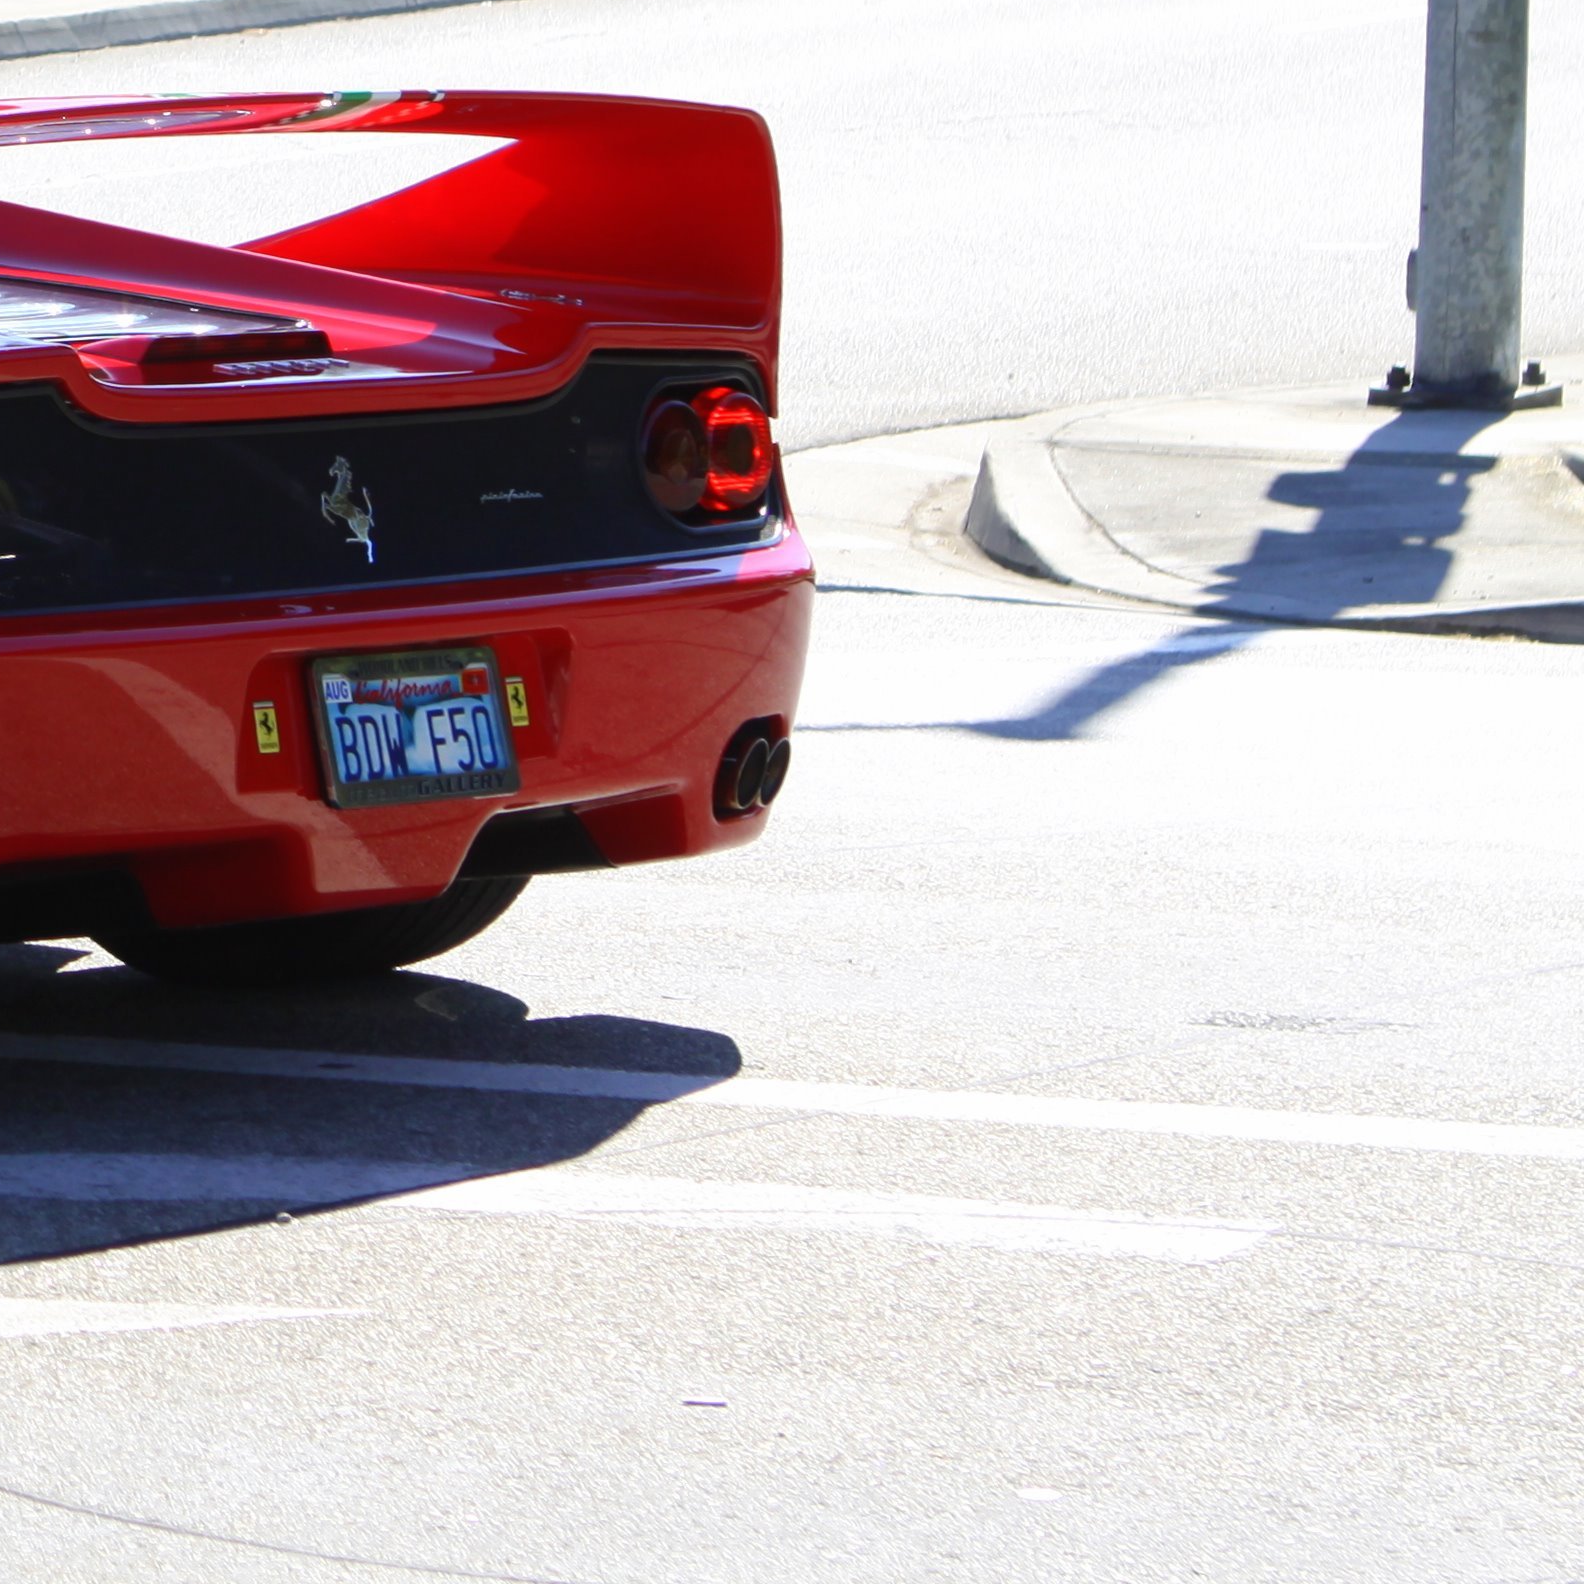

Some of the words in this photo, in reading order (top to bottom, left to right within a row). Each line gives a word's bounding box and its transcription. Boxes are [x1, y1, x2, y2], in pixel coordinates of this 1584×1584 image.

[325, 680, 350, 700] AUG
[353, 677, 458, 709] California
[335, 713, 409, 783] BDW
[426, 704, 499, 775] F50
[417, 772, 508, 797] GALLERY
